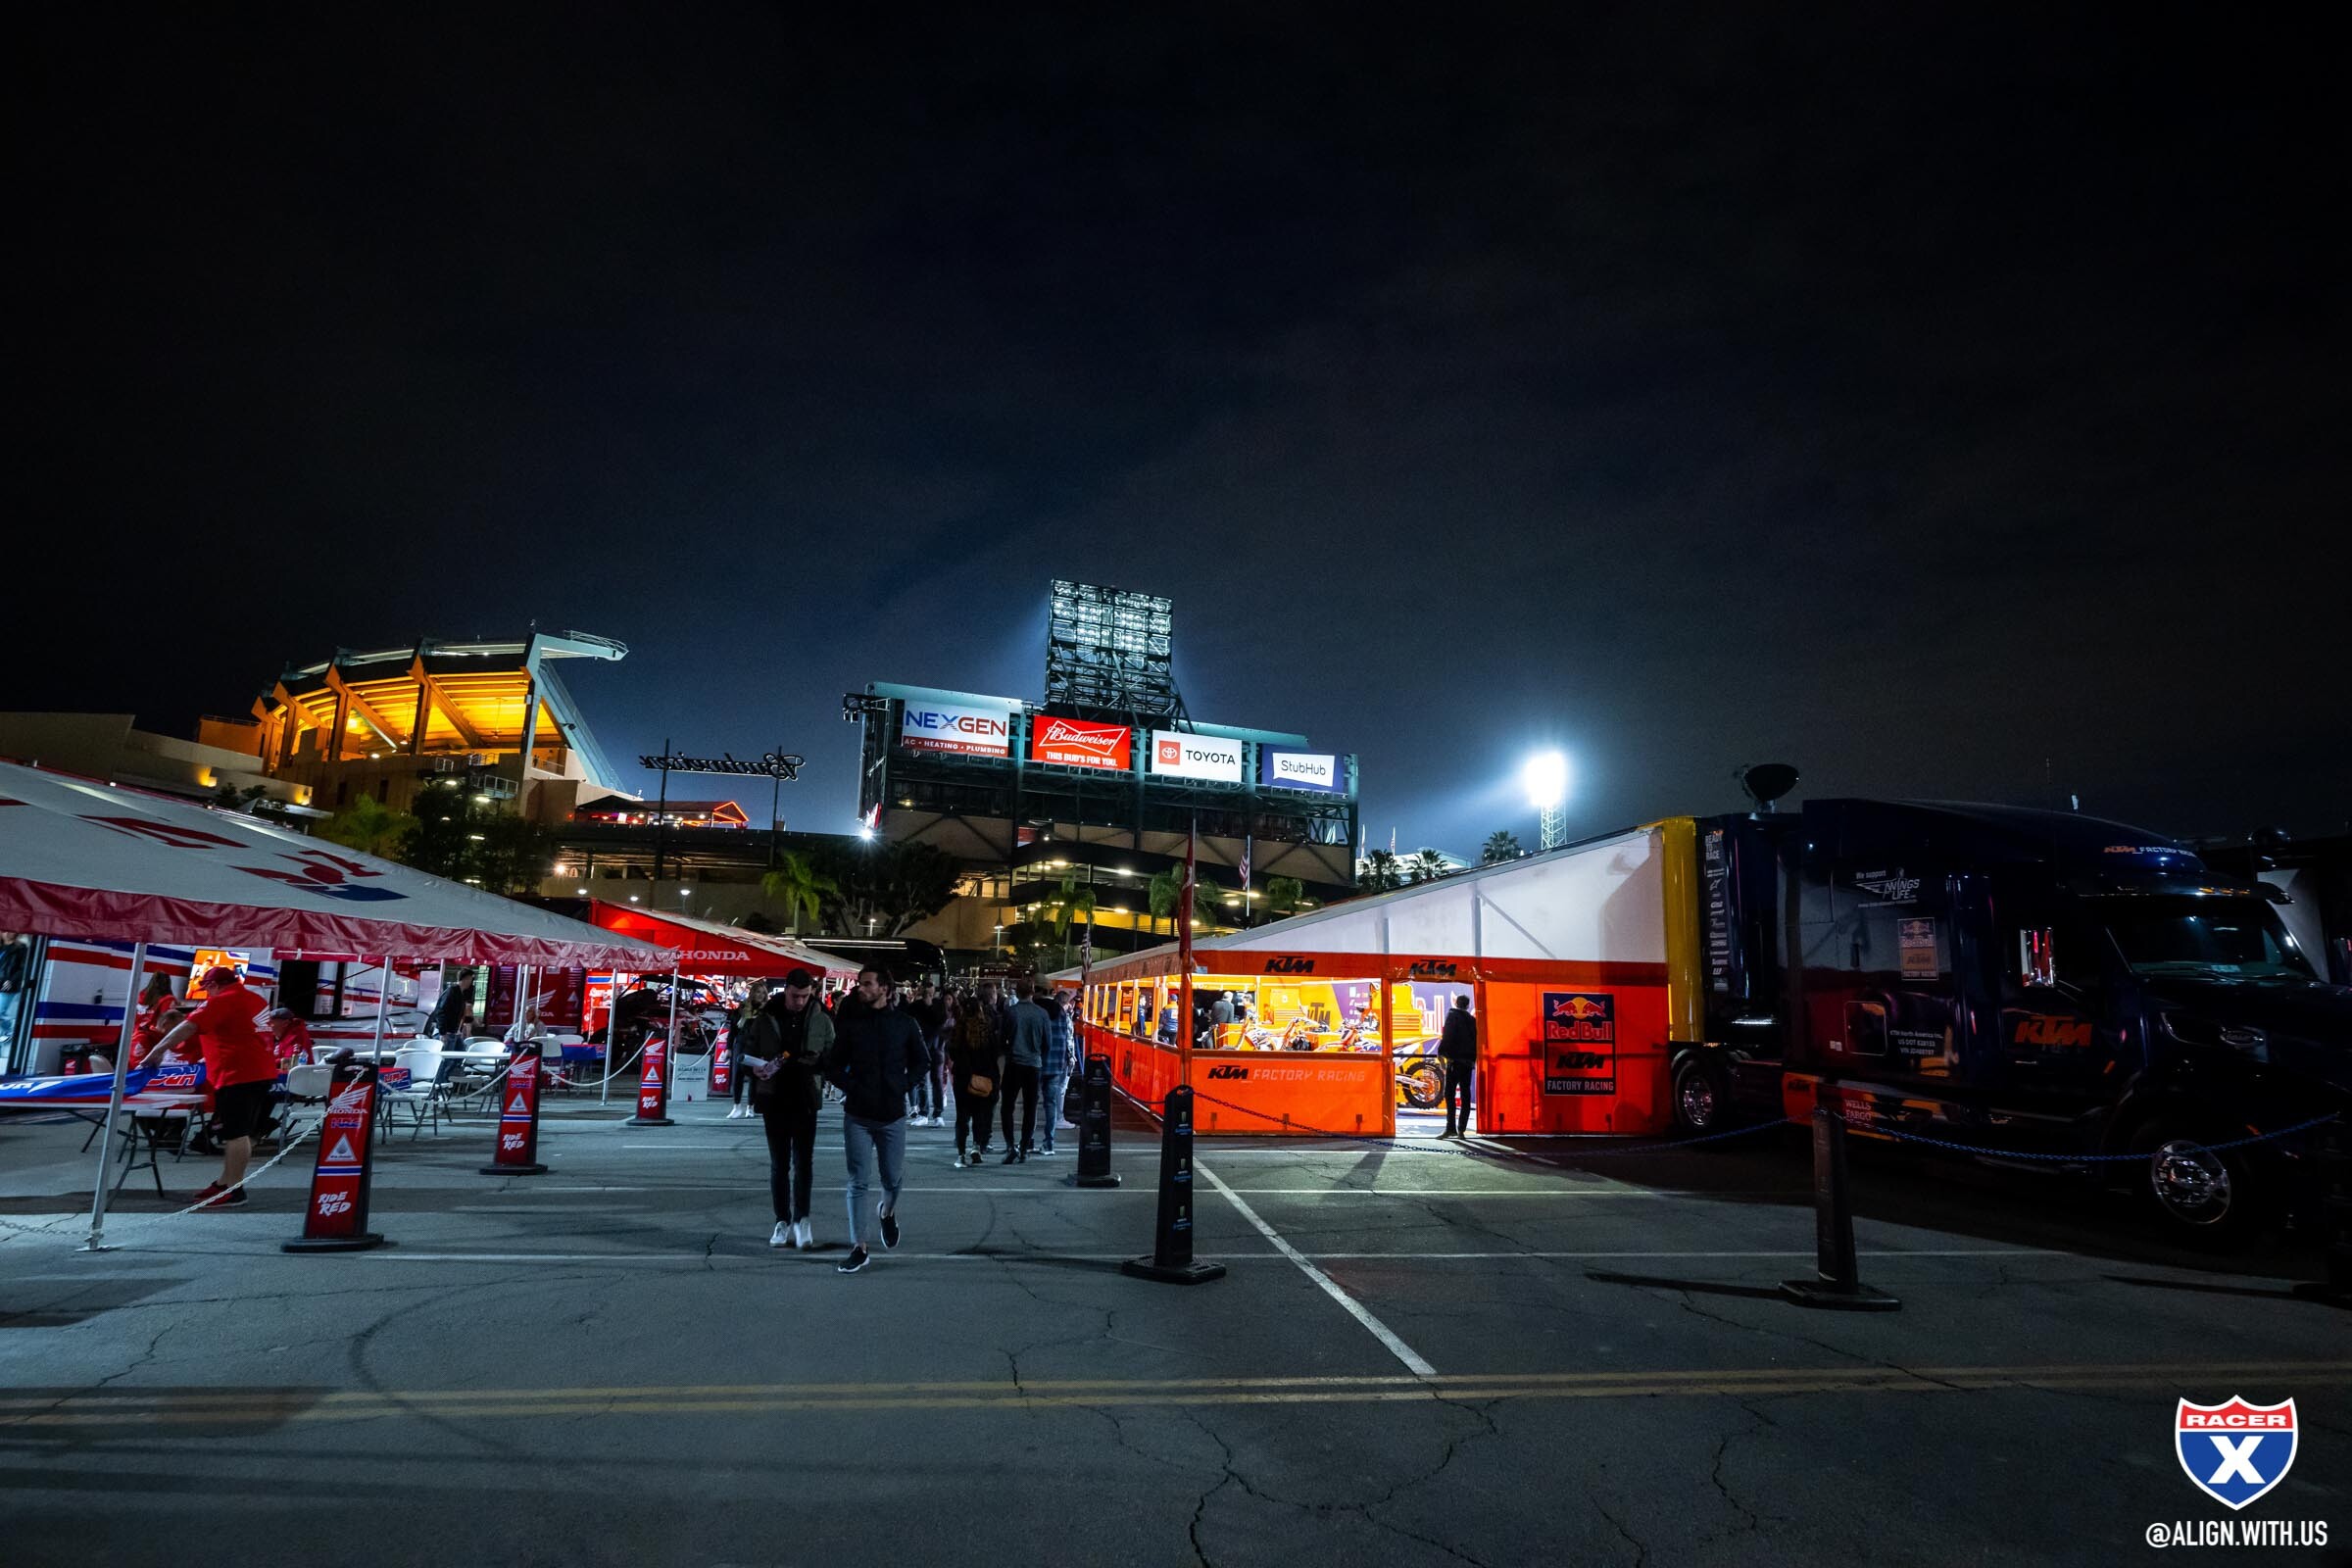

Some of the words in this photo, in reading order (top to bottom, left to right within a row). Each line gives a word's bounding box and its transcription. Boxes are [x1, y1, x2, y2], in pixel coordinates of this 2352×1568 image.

[906, 710, 1006, 737] NEXGEN
[1047, 726, 1115, 746] Budweiser
[924, 740, 958, 751] HEATING
[966, 745, 1005, 755] PLUMBING
[1046, 751, 1062, 761] THIS
[1063, 753, 1086, 763] BUD'S
[1087, 756, 1101, 764] FOR
[1185, 750, 1236, 765] TOYOTA
[1281, 760, 1327, 776] StubHub
[677, 949, 751, 961] HONDA
[1264, 956, 1314, 973] KTM
[1409, 958, 1457, 976] KTM
[1546, 1020, 1580, 1040] Red
[1581, 1020, 1613, 1040] Bull
[2014, 1014, 2093, 1048] KTM
[1556, 1051, 1606, 1069] KTM
[1207, 1064, 1250, 1080] KTM
[1252, 1068, 1313, 1082] FACTORY
[1317, 1069, 1365, 1083] RACING
[1546, 1080, 1583, 1092] FACTORY
[1584, 1081, 1614, 1092] RACING
[504, 1140, 525, 1152] RED
[318, 1191, 349, 1204] RIDE
[318, 1201, 352, 1217] RED
